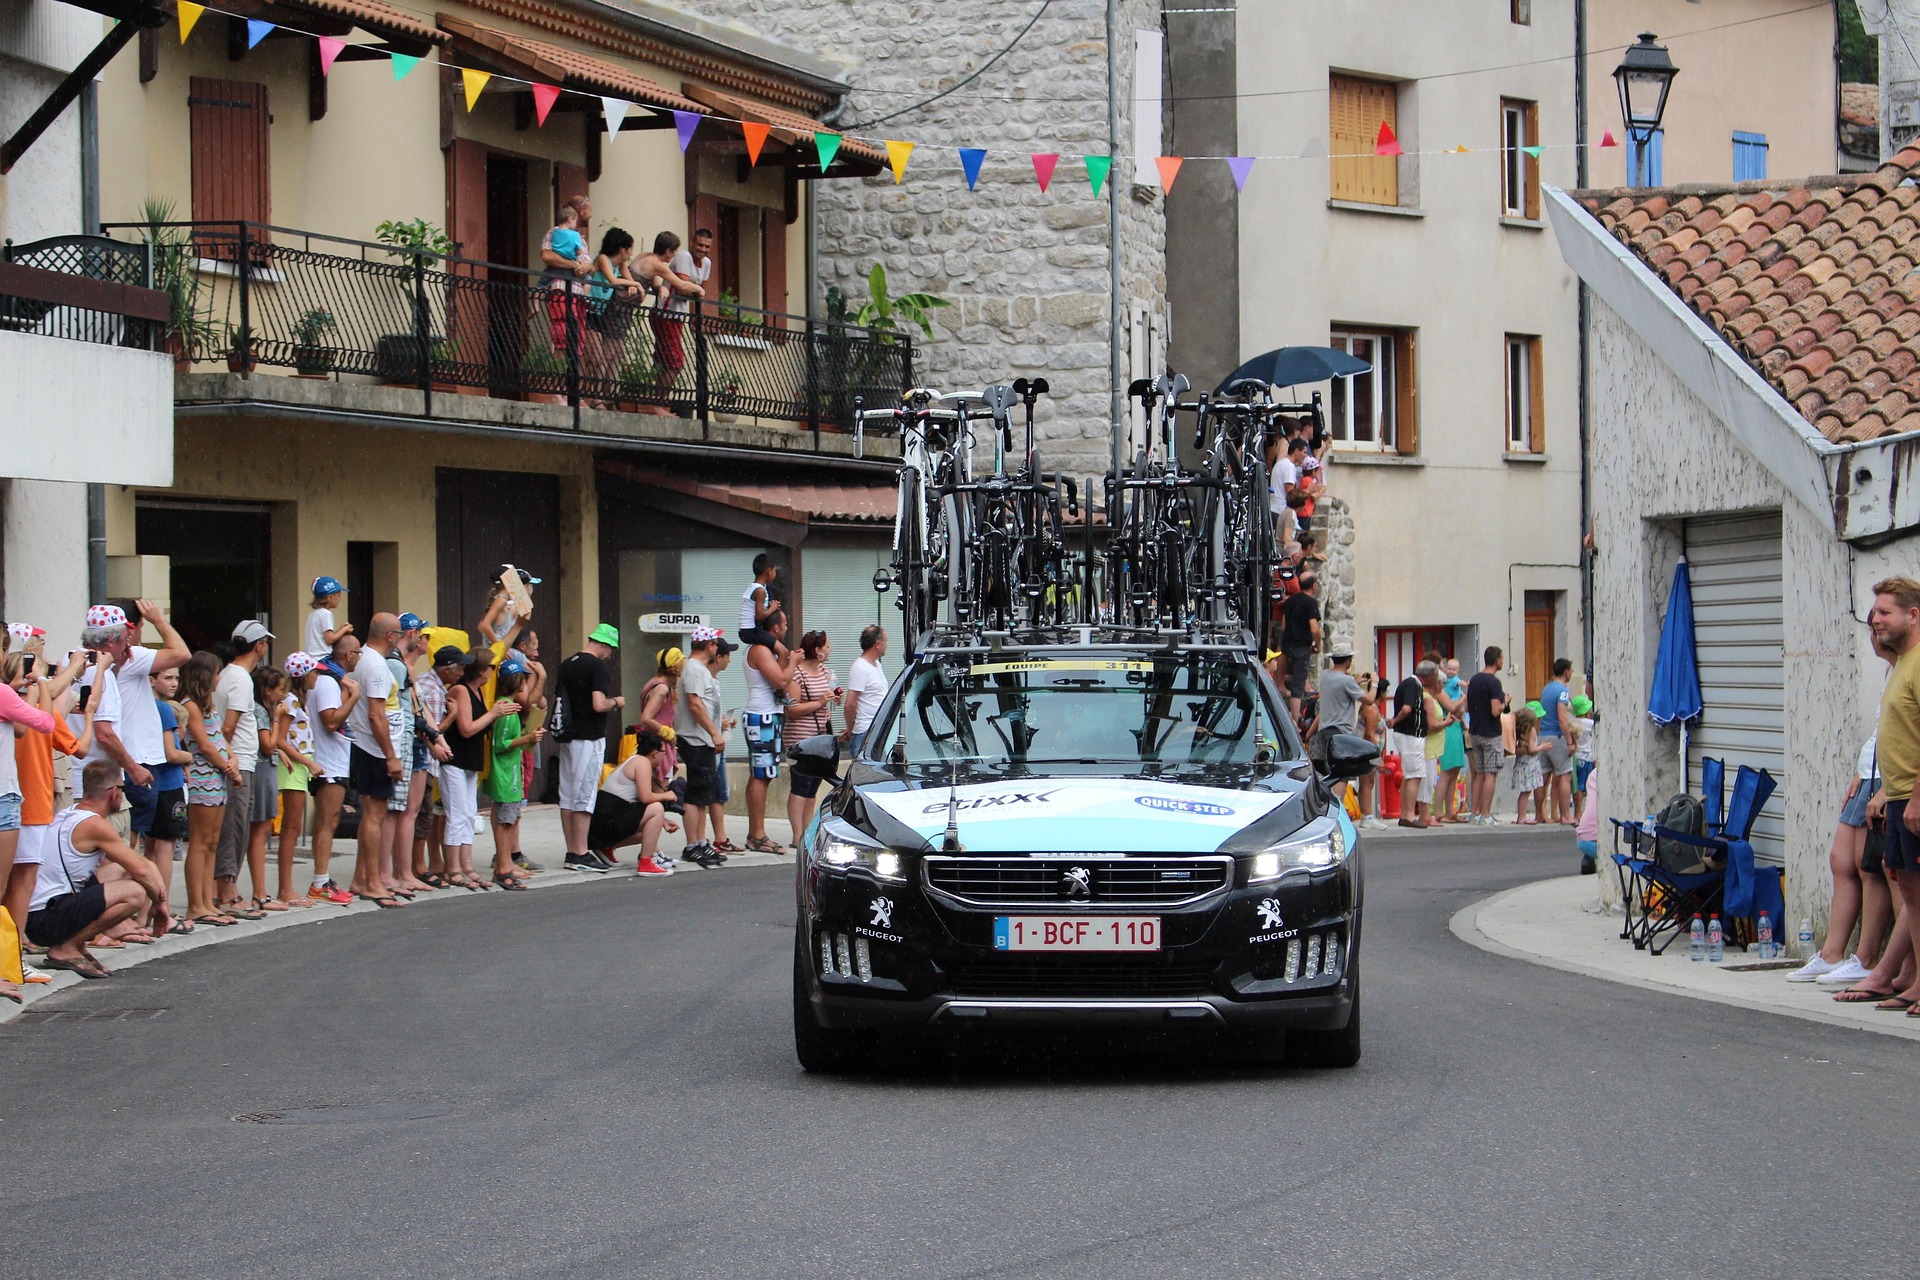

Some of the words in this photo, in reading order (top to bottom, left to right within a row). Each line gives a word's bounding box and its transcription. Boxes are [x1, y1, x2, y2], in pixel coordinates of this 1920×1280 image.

[659, 615, 700, 624] SUPRA
[1105, 662, 1142, 670] 311
[922, 790, 1046, 814] etixx
[1140, 797, 1189, 811] QUICK
[1194, 804, 1231, 815] STEP
[855, 926, 904, 943] PEUGEOT
[996, 936, 1007, 947] B
[1249, 929, 1299, 944] PEUGEOT
